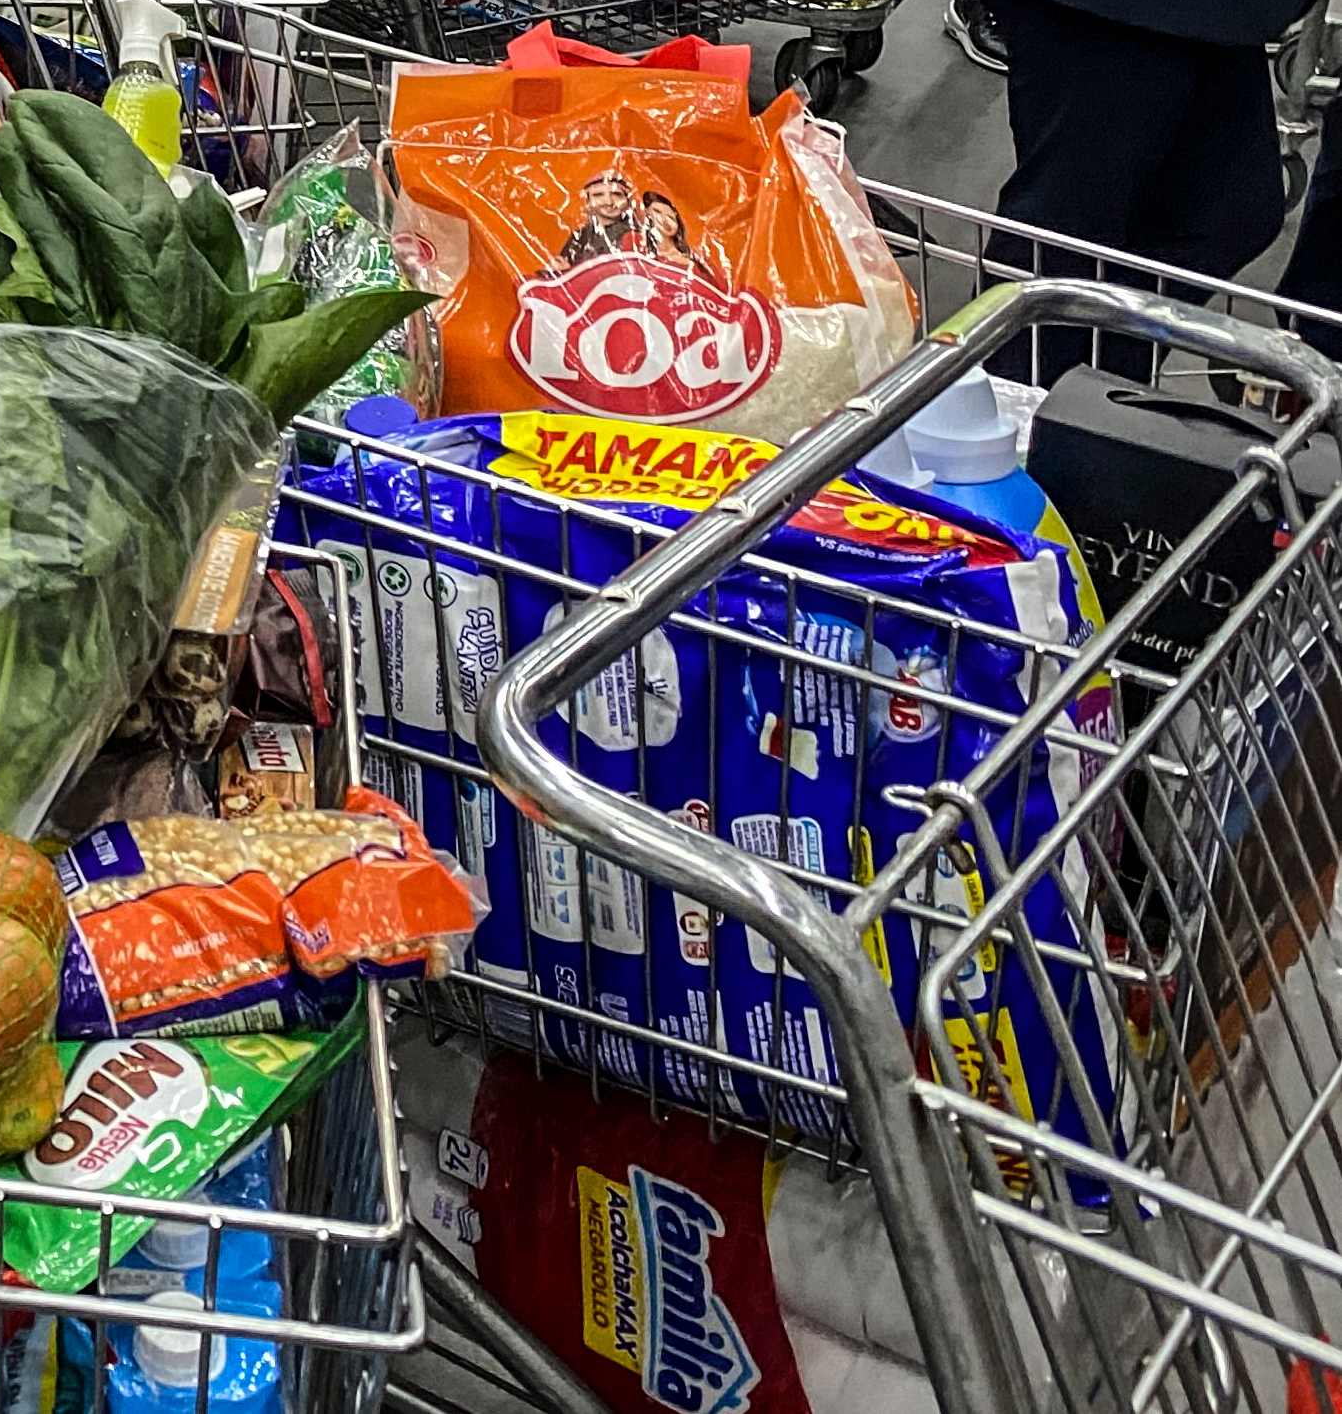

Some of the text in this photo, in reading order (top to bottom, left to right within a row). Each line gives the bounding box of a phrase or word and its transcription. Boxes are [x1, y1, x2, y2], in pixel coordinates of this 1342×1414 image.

[672, 290, 733, 319] arroz
[34, 1041, 186, 1166] MILO
[76, 1113, 150, 1171] Nestlé
[445, 1135, 472, 1174] 24
[605, 1186, 638, 1359] AcolchaMAX
[654, 1180, 738, 1413] familia
